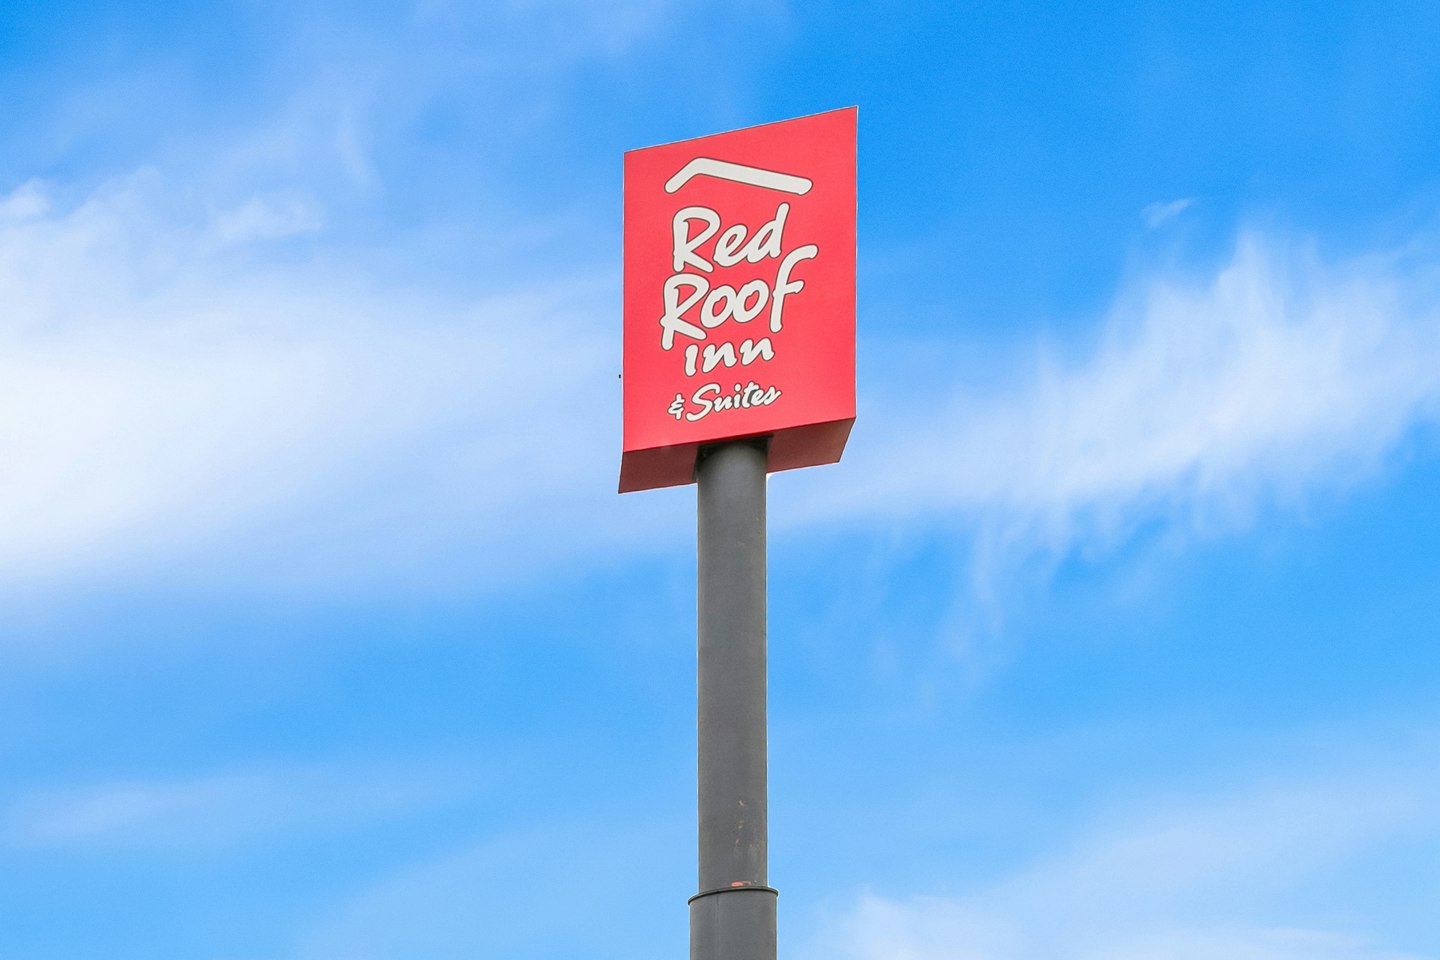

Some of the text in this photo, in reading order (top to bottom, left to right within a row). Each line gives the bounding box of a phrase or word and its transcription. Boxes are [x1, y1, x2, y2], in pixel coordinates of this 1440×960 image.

[672, 202, 790, 272] Red
[660, 244, 818, 350] Roof
[667, 382, 781, 422] & Suites
